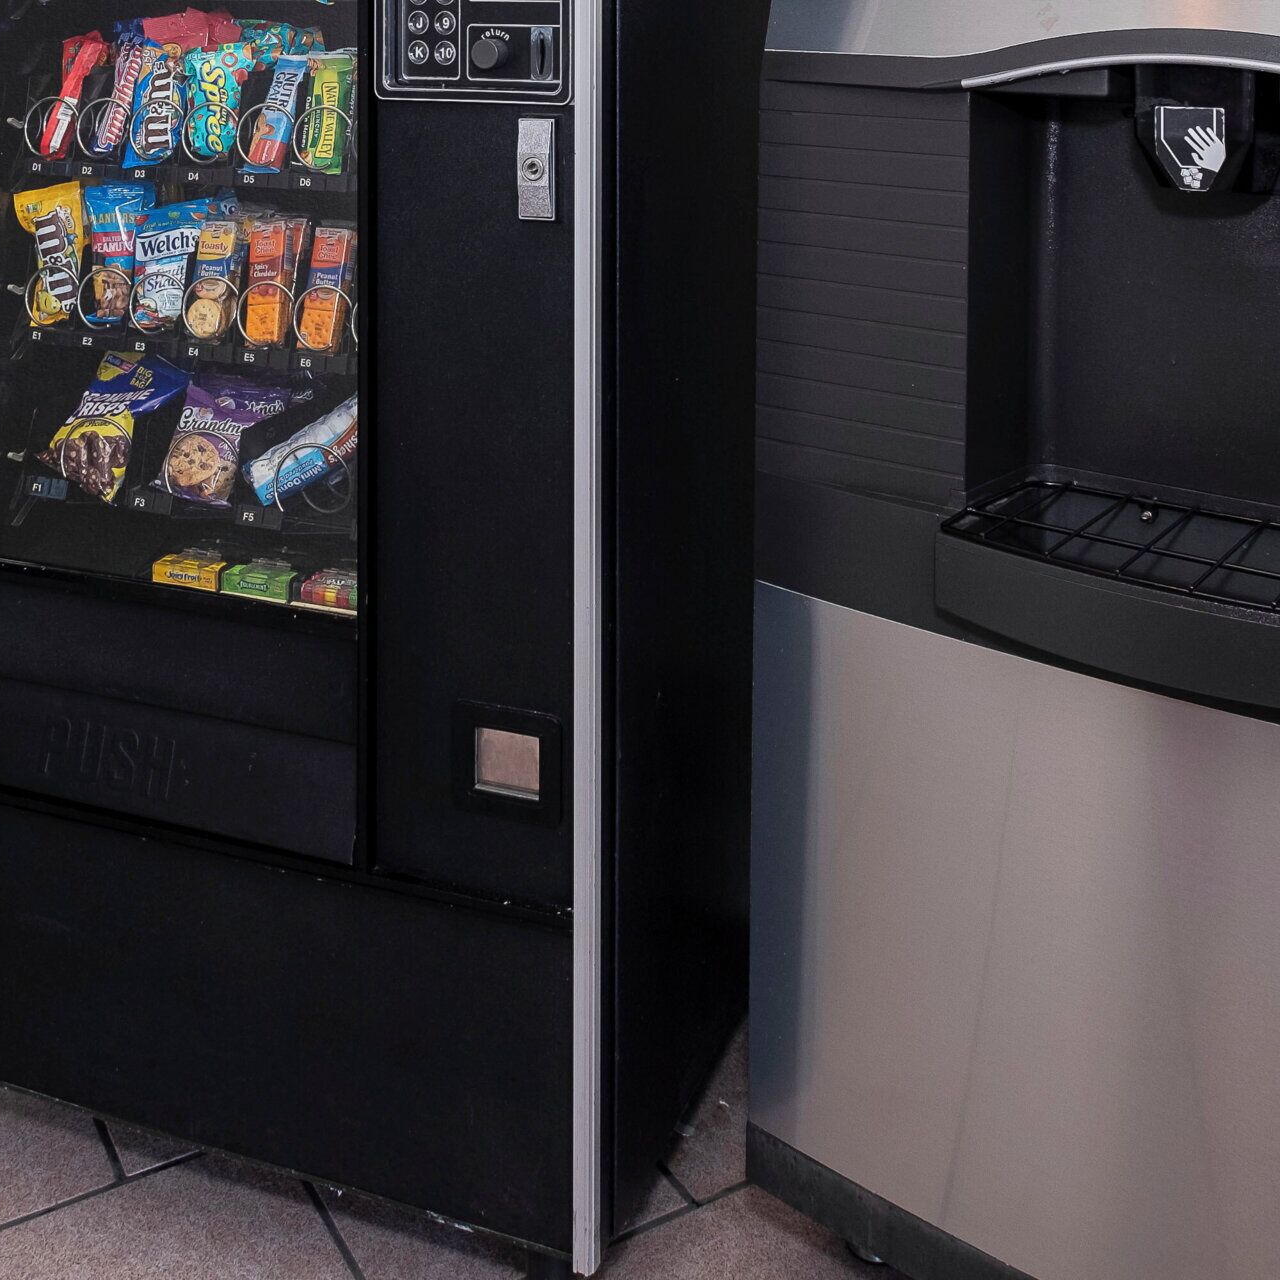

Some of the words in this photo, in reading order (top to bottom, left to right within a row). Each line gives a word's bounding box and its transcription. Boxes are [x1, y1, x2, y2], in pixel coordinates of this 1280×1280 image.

[416, 18, 423, 29] J
[442, 18, 450, 29] 9
[480, 28, 511, 41] return
[416, 47, 424, 58] K
[440, 47, 452, 58] 10
[318, 122, 336, 156] VALLEY
[32, 162, 42, 171] D1
[82, 166, 92, 174] D2
[134, 170, 146, 178] D3
[188, 172, 199, 180] D4
[243, 175, 255, 184] D5
[300, 178, 311, 186] D6
[140, 231, 199, 258] Welch's
[200, 240, 229, 252] Toasty
[254, 270, 277, 278] Cheddar
[316, 272, 338, 280] Peanut
[315, 278, 336, 286] Butter
[32, 331, 42, 340] E1
[82, 336, 93, 346] E2
[134, 342, 146, 350] E3
[188, 348, 199, 356] E4
[243, 353, 255, 362] E5
[300, 358, 312, 368] E6
[32, 484, 42, 492] F1
[134, 497, 145, 506] F3
[242, 512, 254, 522] F5
